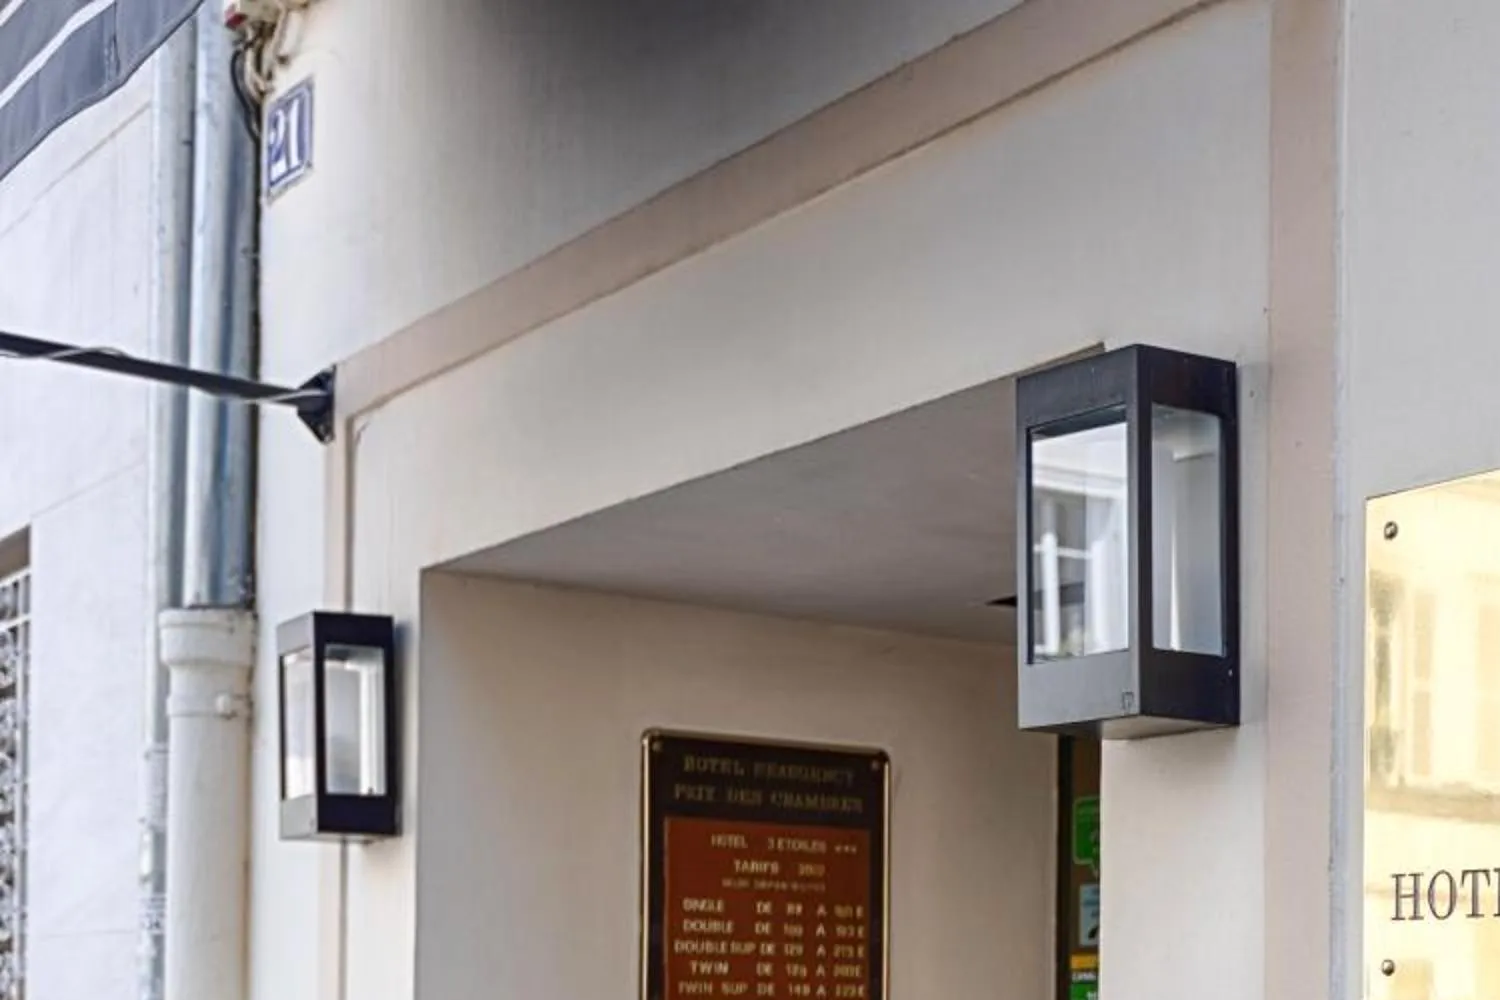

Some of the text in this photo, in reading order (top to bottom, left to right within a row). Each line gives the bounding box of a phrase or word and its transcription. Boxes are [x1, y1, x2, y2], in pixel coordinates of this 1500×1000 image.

[269, 98, 301, 182] 21
[683, 918, 734, 934] DOUBLE
[690, 960, 729, 975] TWIN
